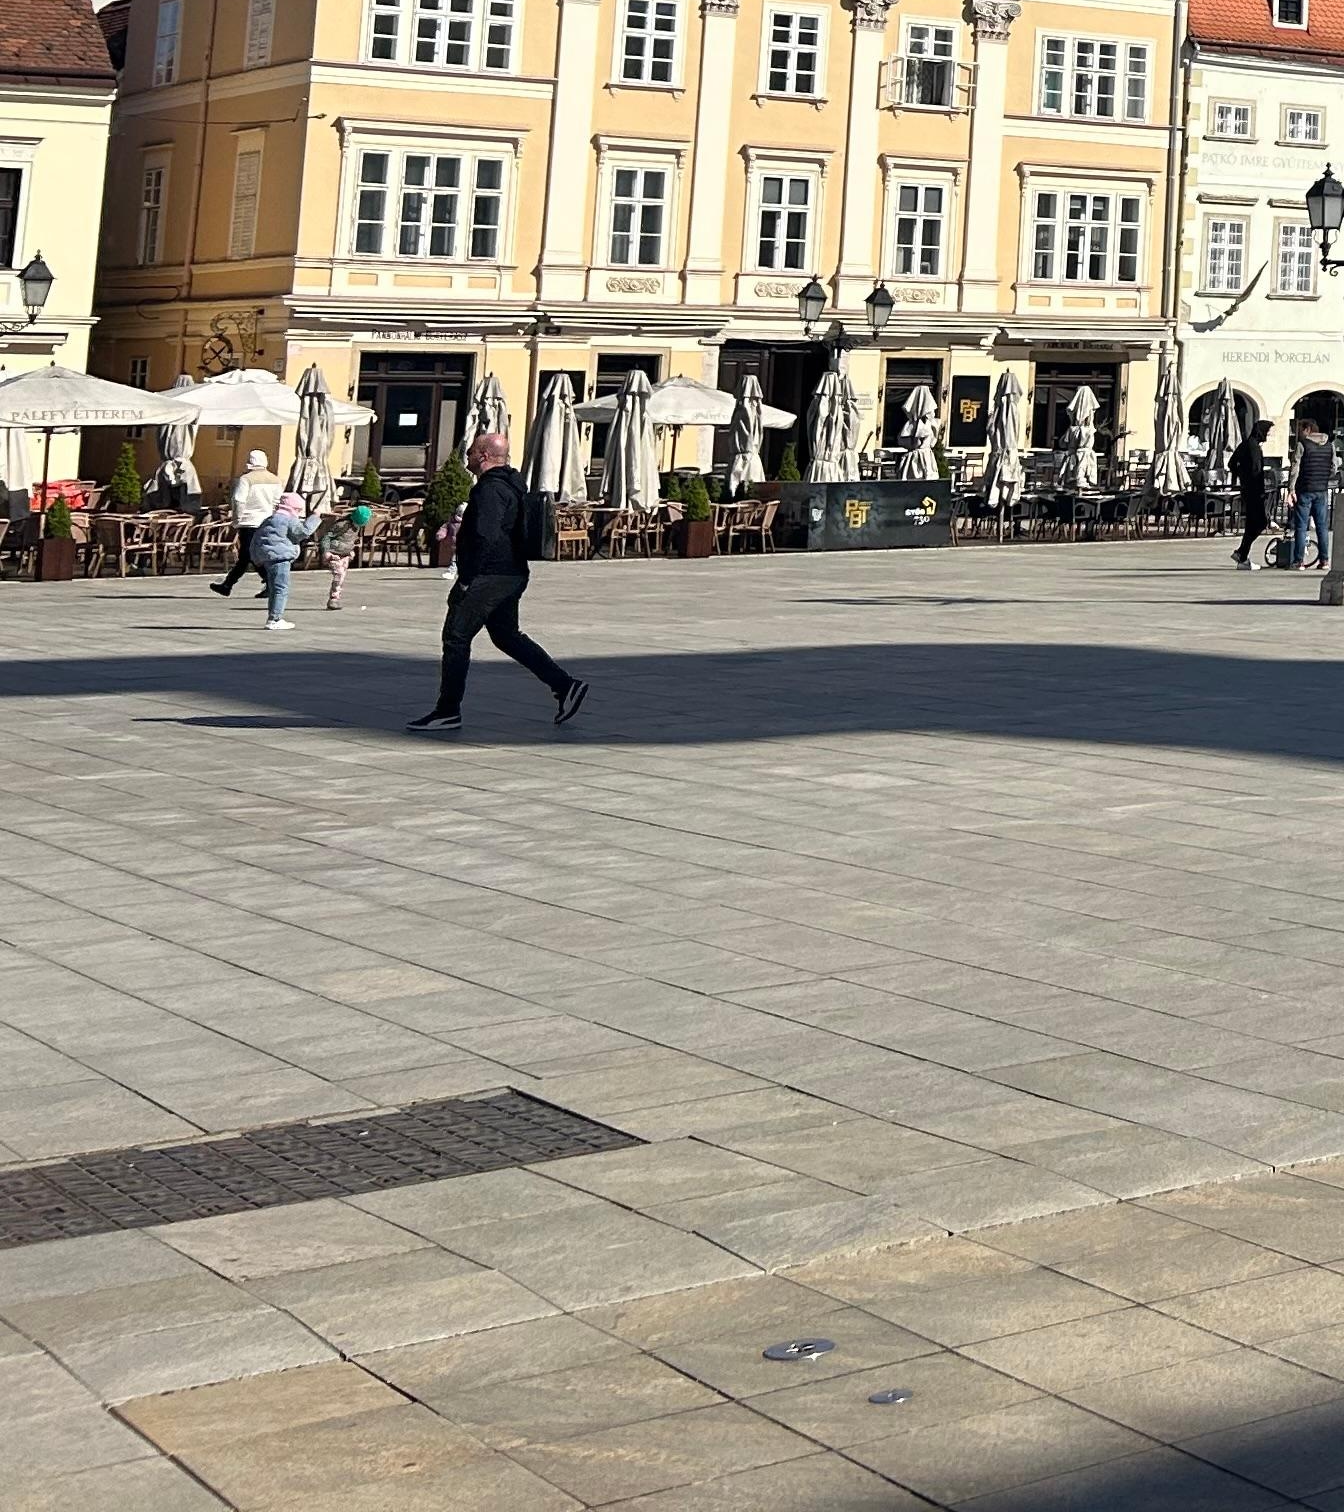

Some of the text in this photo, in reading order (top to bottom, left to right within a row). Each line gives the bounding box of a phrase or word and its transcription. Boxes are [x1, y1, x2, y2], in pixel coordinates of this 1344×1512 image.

[1240, 154, 1269, 168] IMRE
[1222, 349, 1331, 364] HERENDI PORCELÁN
[11, 407, 70, 421] PÁLFFY
